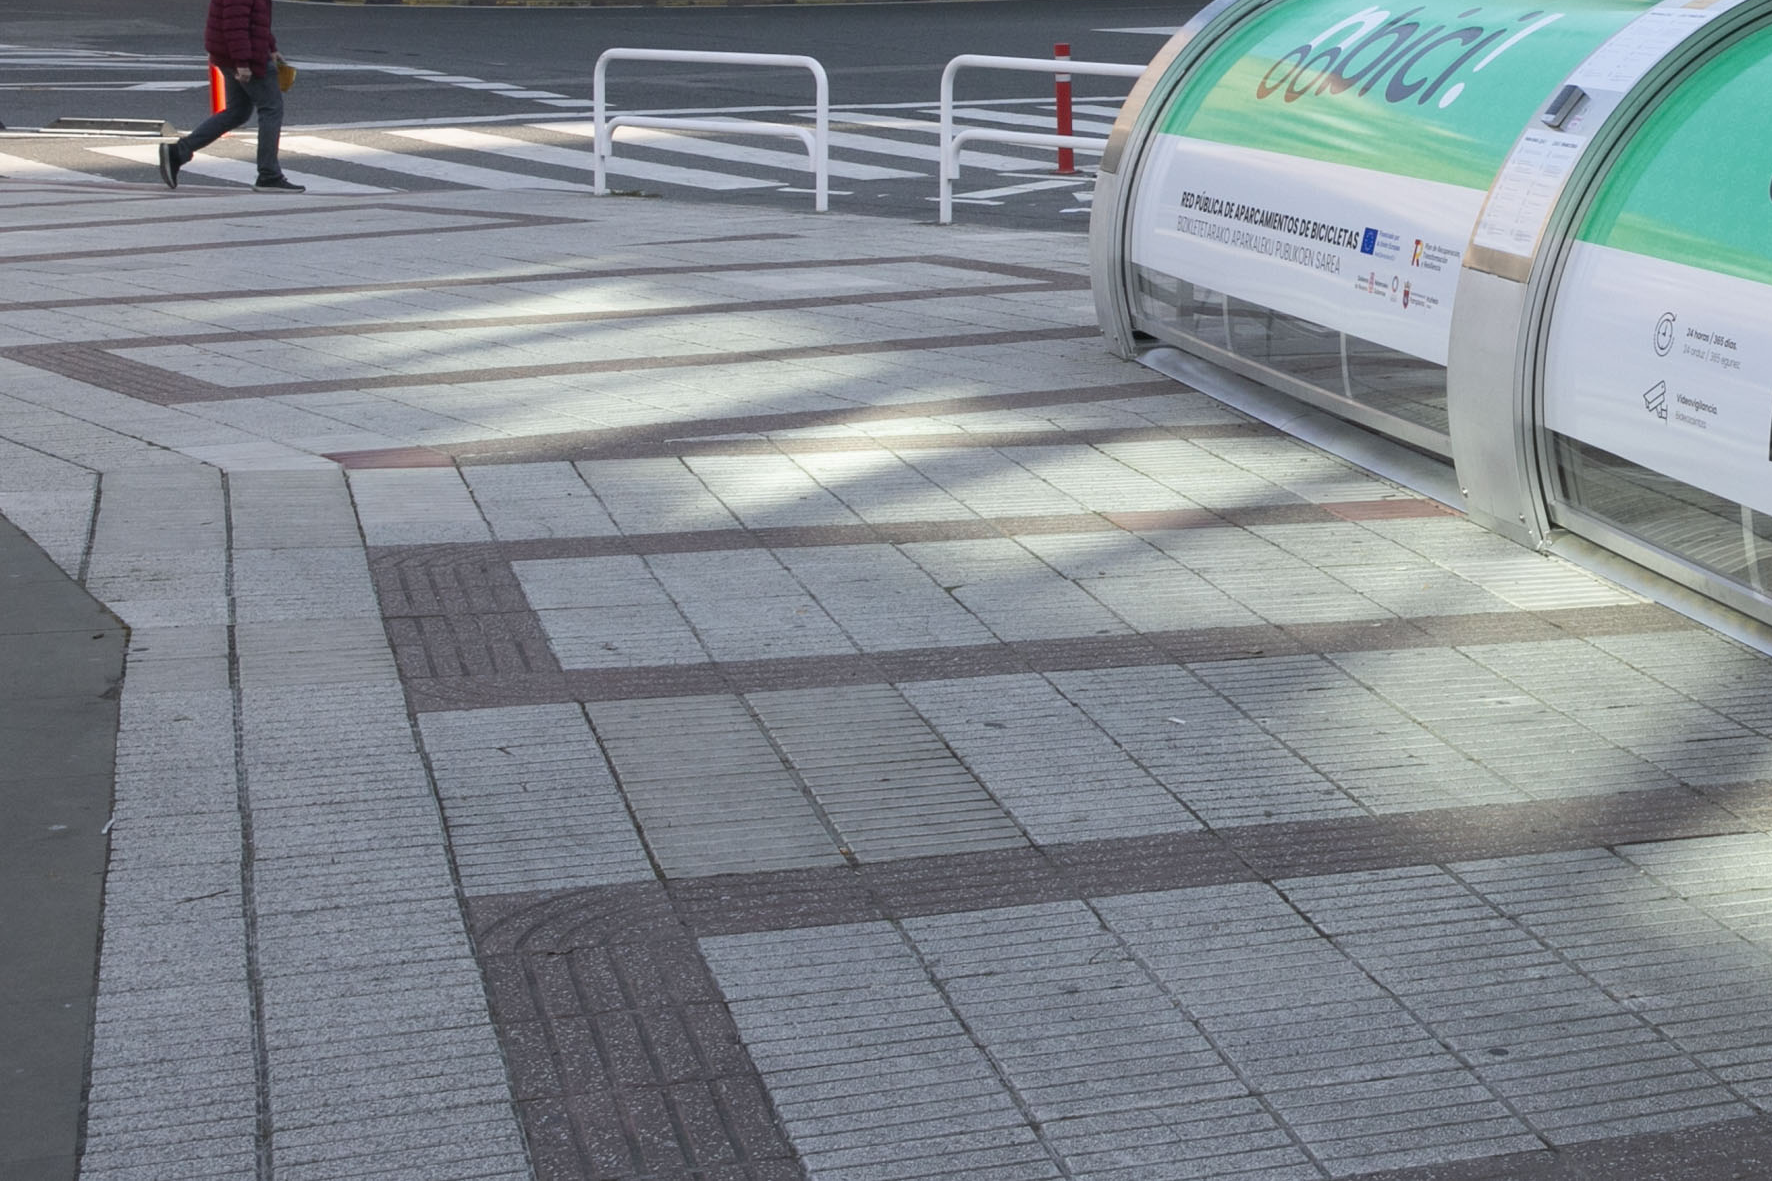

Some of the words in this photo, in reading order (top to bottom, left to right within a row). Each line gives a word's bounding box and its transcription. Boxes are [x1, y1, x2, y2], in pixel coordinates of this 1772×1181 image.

[1181, 191, 1195, 208] RED
[1195, 190, 1224, 217] PÚBLICA
[1223, 201, 1235, 219] DE
[1234, 204, 1299, 235] APARCAMIENTOS
[1299, 218, 1311, 238] DE
[1310, 221, 1360, 250] BICICLETAS
[1231, 229, 1274, 257] APARKALEKU
[1315, 250, 1341, 275] SAREA
[1686, 327, 1694, 338] 24
[1694, 330, 1709, 343] horas
[1708, 331, 1715, 345] /
[1713, 334, 1724, 346] 365
[1682, 343, 1690, 354] 24
[1710, 351, 1721, 364] 365
